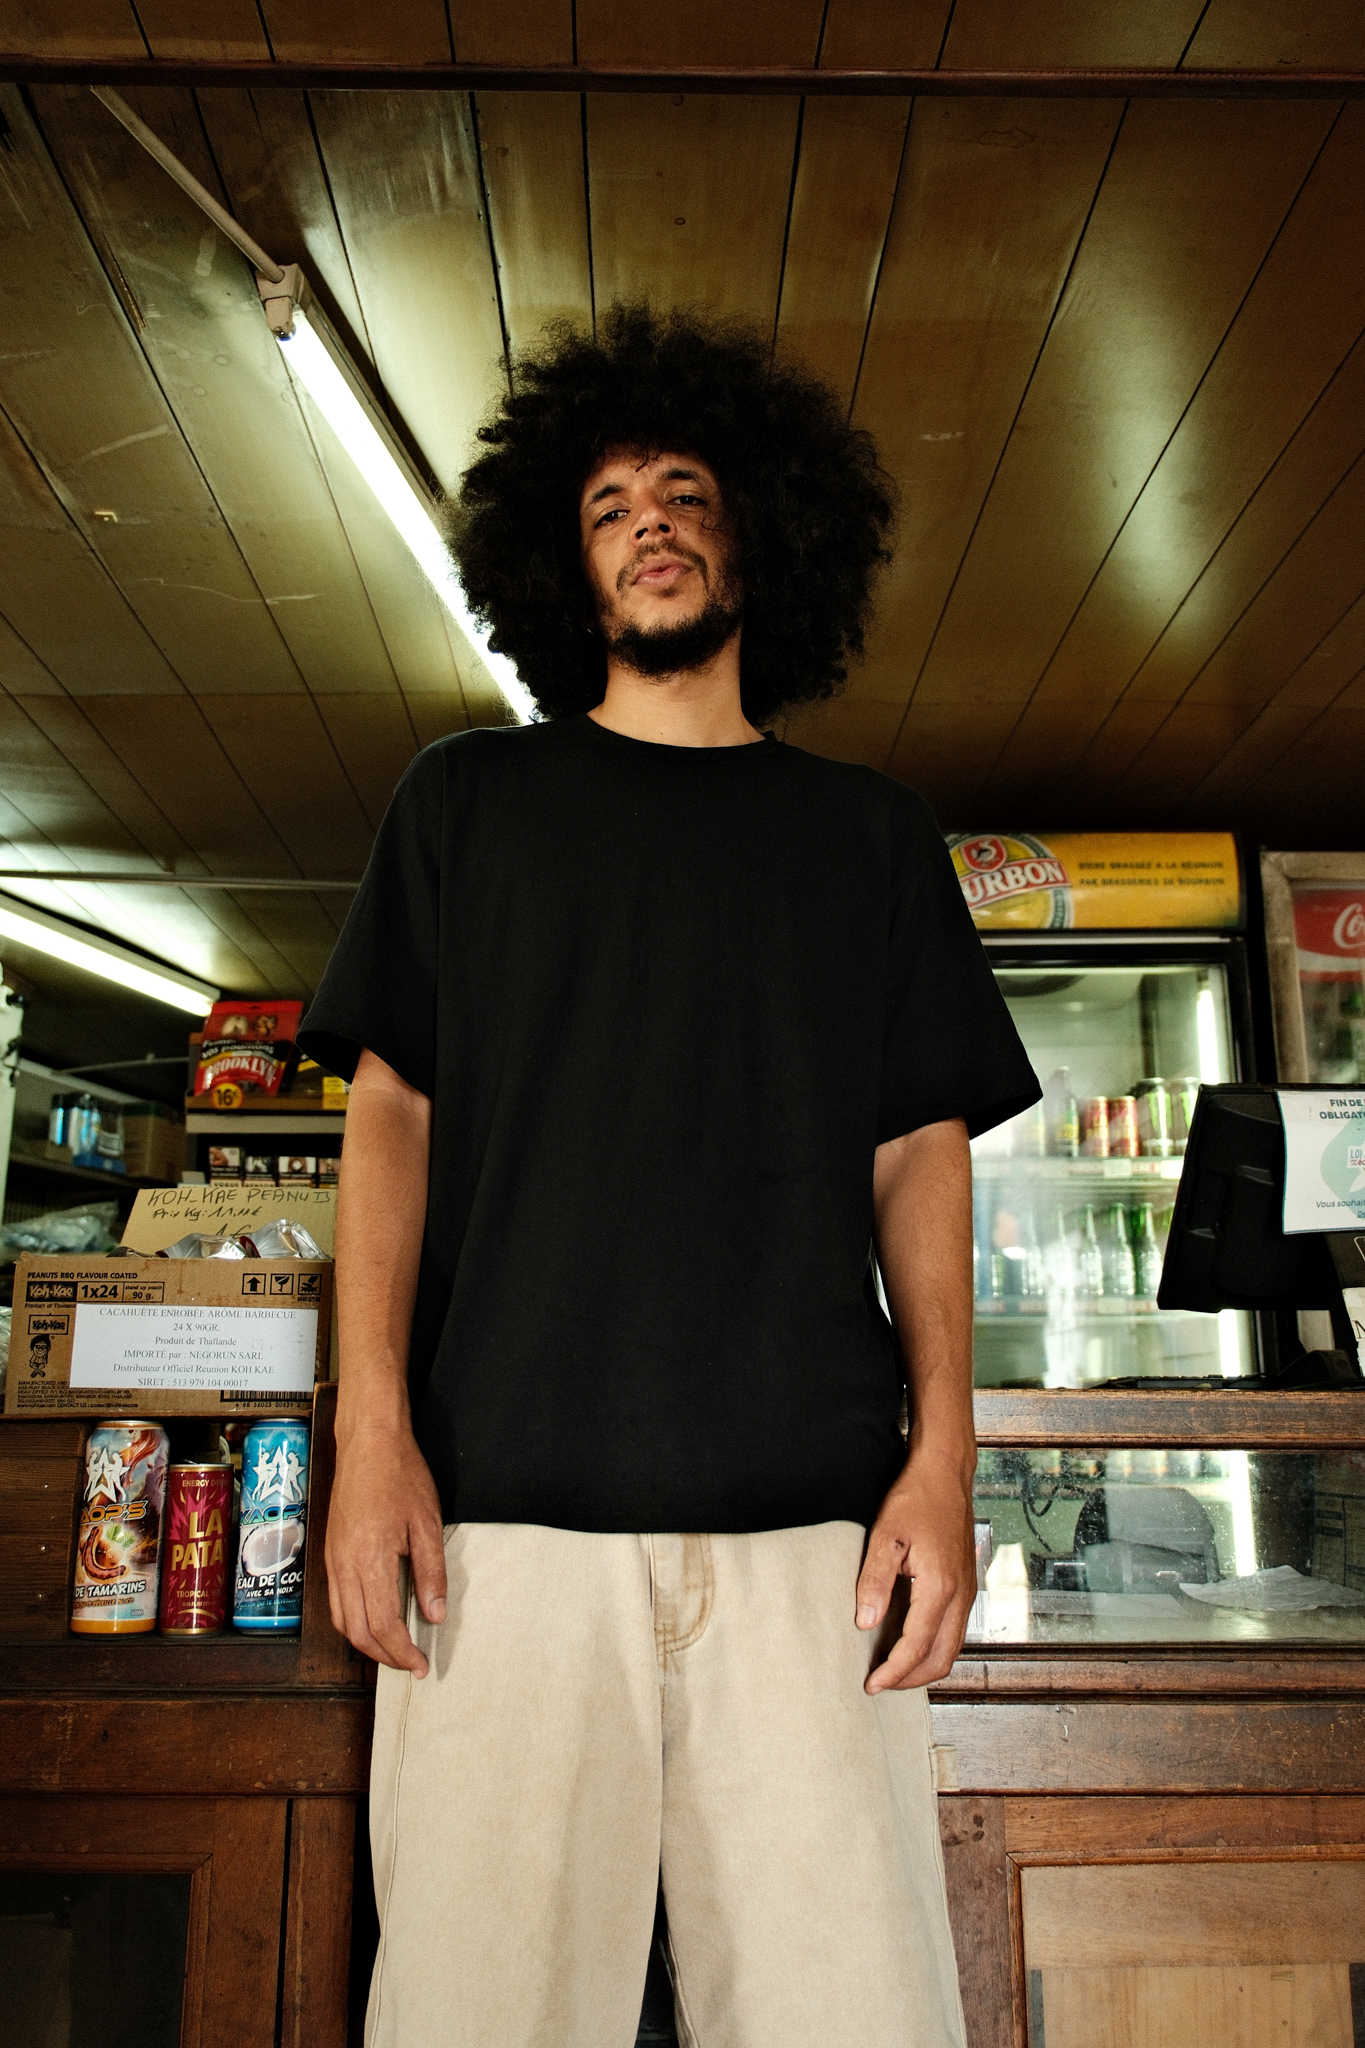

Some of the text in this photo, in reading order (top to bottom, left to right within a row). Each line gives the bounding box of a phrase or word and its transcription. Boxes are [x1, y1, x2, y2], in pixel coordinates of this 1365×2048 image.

[1329, 1099, 1362, 1107] FIN DE
[1316, 1200, 1336, 1208] Vous
[29, 1283, 74, 1299] Koh-Kae
[81, 1284, 119, 1299] 1x24
[132, 1291, 154, 1300] 90 g.
[99, 1306, 297, 1319] CACAHUÈTE ENROBÉE ARÔME BARBECUE
[173, 1322, 183, 1331] 24
[185, 1323, 193, 1331] X
[155, 1336, 237, 1346] Produit de Thaïlande
[123, 1348, 166, 1358] IMPORTÉ
[168, 1353, 182, 1361] par
[189, 1351, 237, 1360] NEGORUN
[238, 1351, 264, 1360] SARL
[113, 1363, 161, 1372] Distributeur
[162, 1364, 194, 1373] Officiel
[231, 1365, 252, 1374] KOH
[254, 1366, 275, 1374] KAE
[137, 1377, 165, 1386] SIRET
[172, 1378, 187, 1387] 513
[189, 1378, 205, 1387] 979
[207, 1379, 221, 1387] 104
[223, 1379, 249, 1387] 00017
[182, 1479, 210, 1487] ENERGY
[189, 1508, 223, 1539] LA
[171, 1538, 224, 1571] PATA
[237, 1576, 256, 1590] EAU
[258, 1573, 276, 1588] DE
[75, 1580, 147, 1598] DE TAMARINS
[176, 1590, 210, 1598] TROPICAL
[246, 1585, 294, 1598] AVEC SA NOIX
